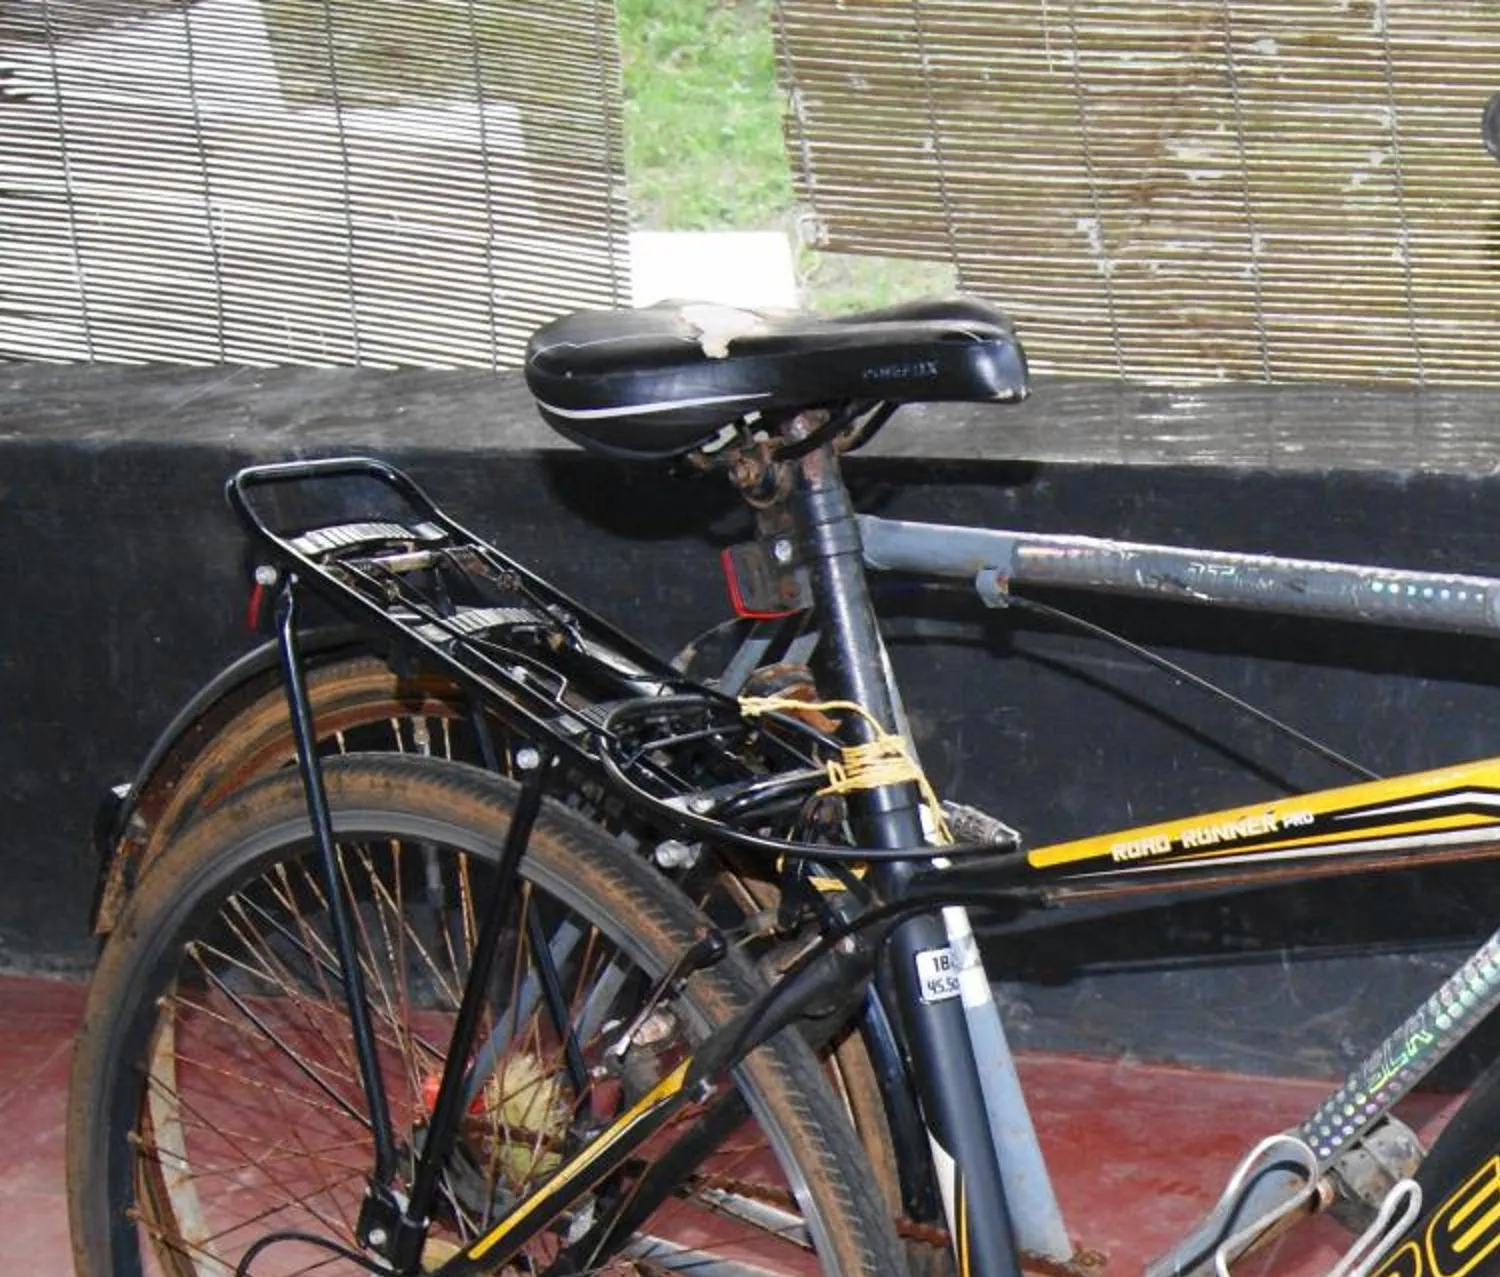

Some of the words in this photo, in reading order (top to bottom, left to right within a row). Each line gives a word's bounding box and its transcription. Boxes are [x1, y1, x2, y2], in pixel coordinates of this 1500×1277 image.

[1111, 832, 1172, 863] ROAD
[1180, 811, 1279, 849] RUNNER
[1282, 810, 1315, 829] PRO
